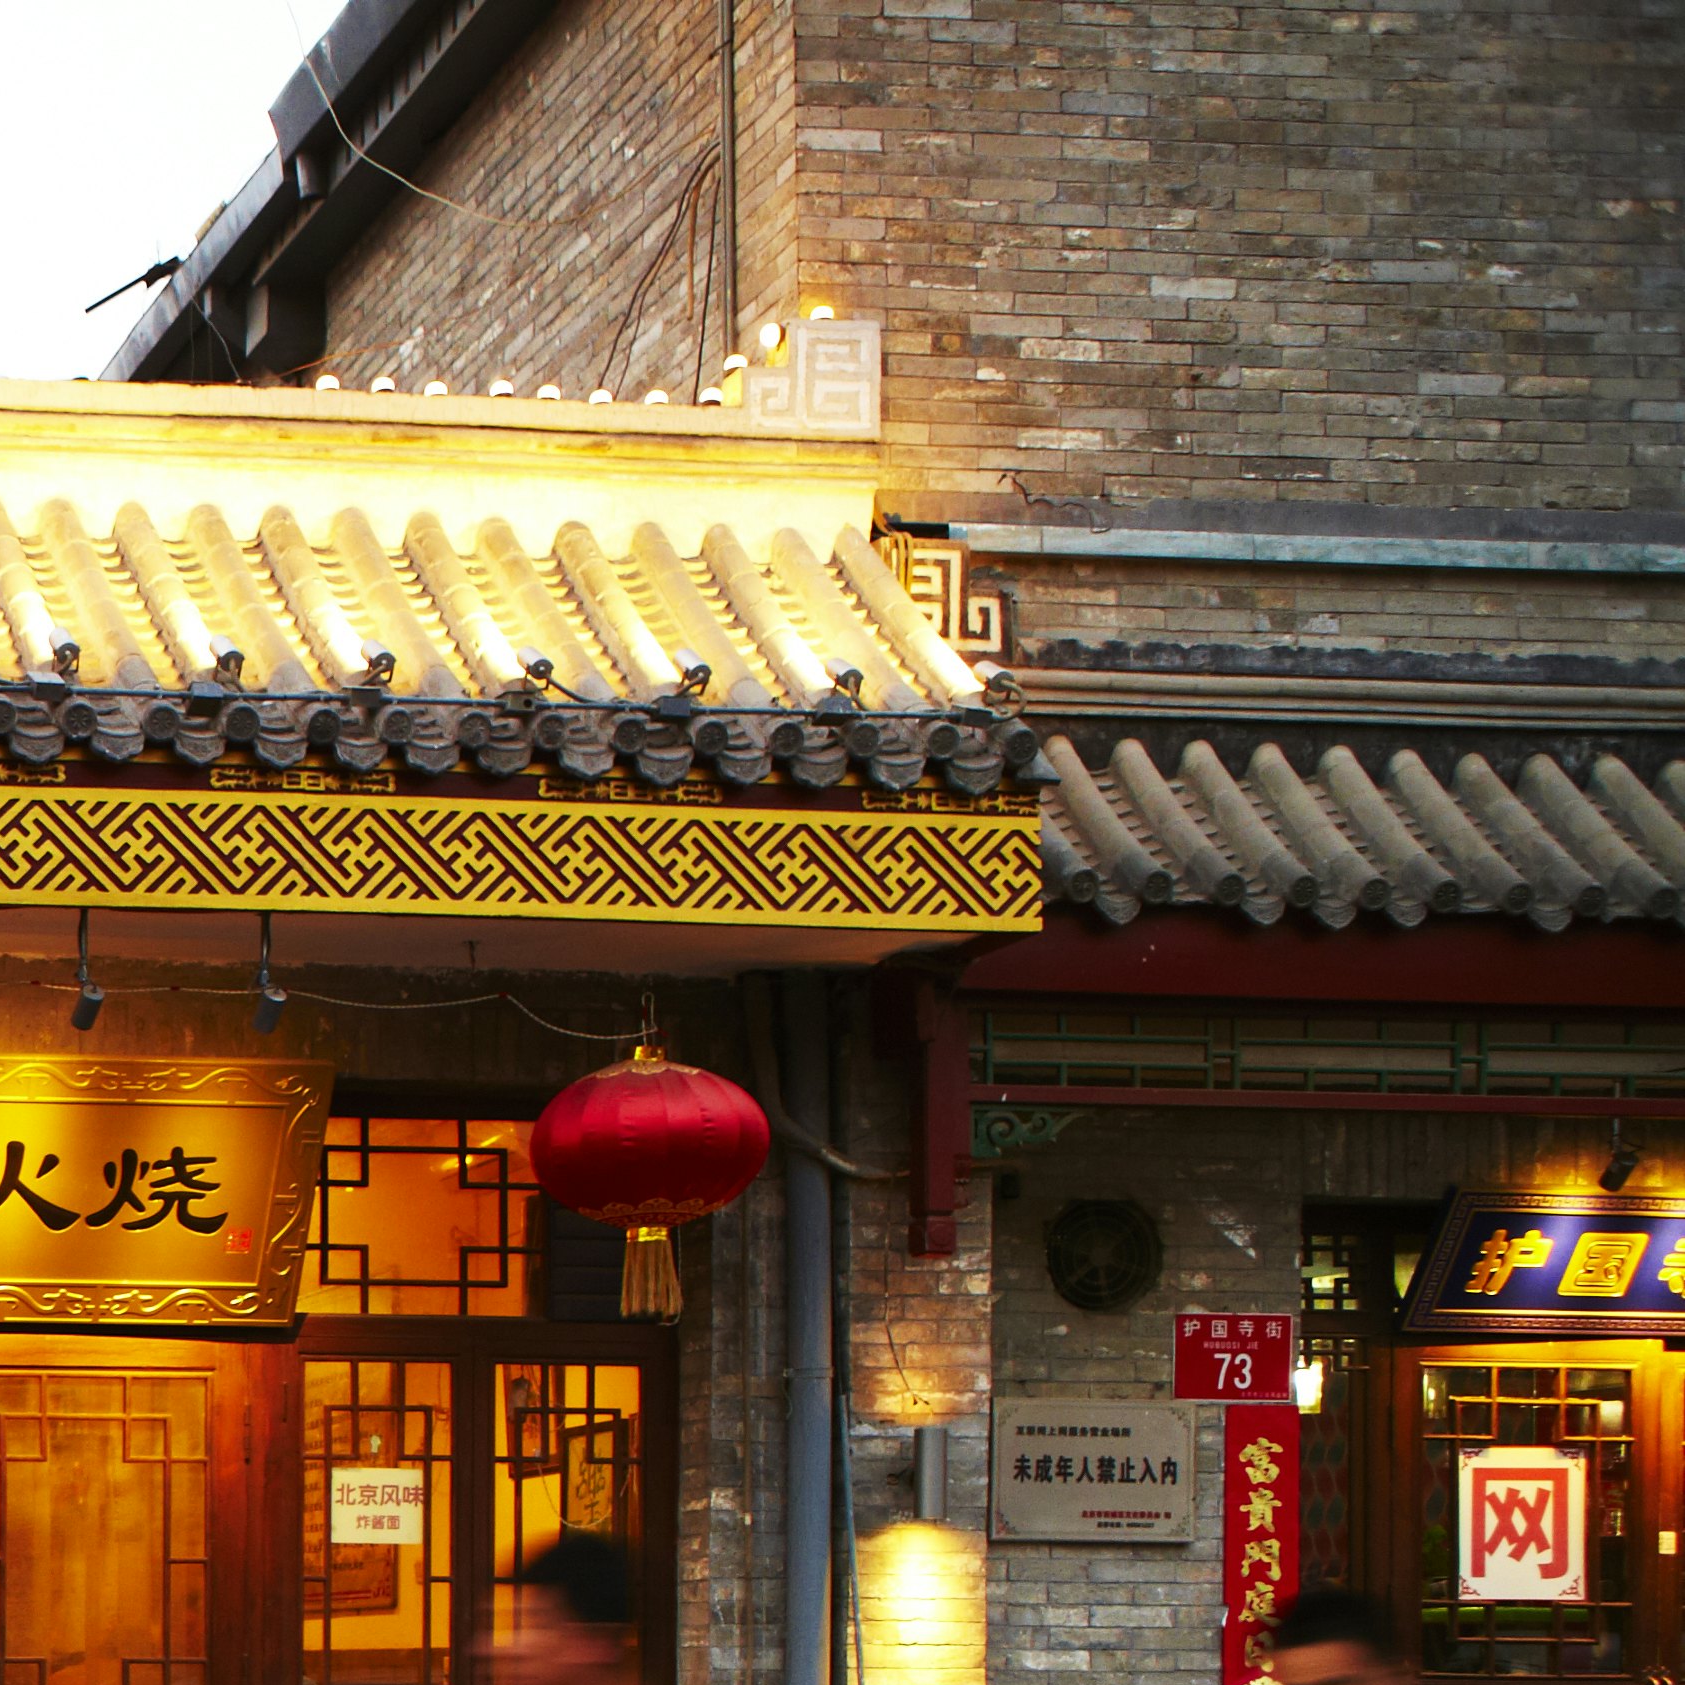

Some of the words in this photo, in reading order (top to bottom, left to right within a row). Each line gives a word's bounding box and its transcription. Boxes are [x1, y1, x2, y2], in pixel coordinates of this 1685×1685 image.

[1182, 1318, 1284, 1339] 护国寺街
[1213, 1352, 1253, 1390] 73
[1012, 1454, 1179, 1486] 未成年人禁止入内
[335, 1483, 425, 1508] 北京风味
[1470, 1467, 1570, 1580] 网
